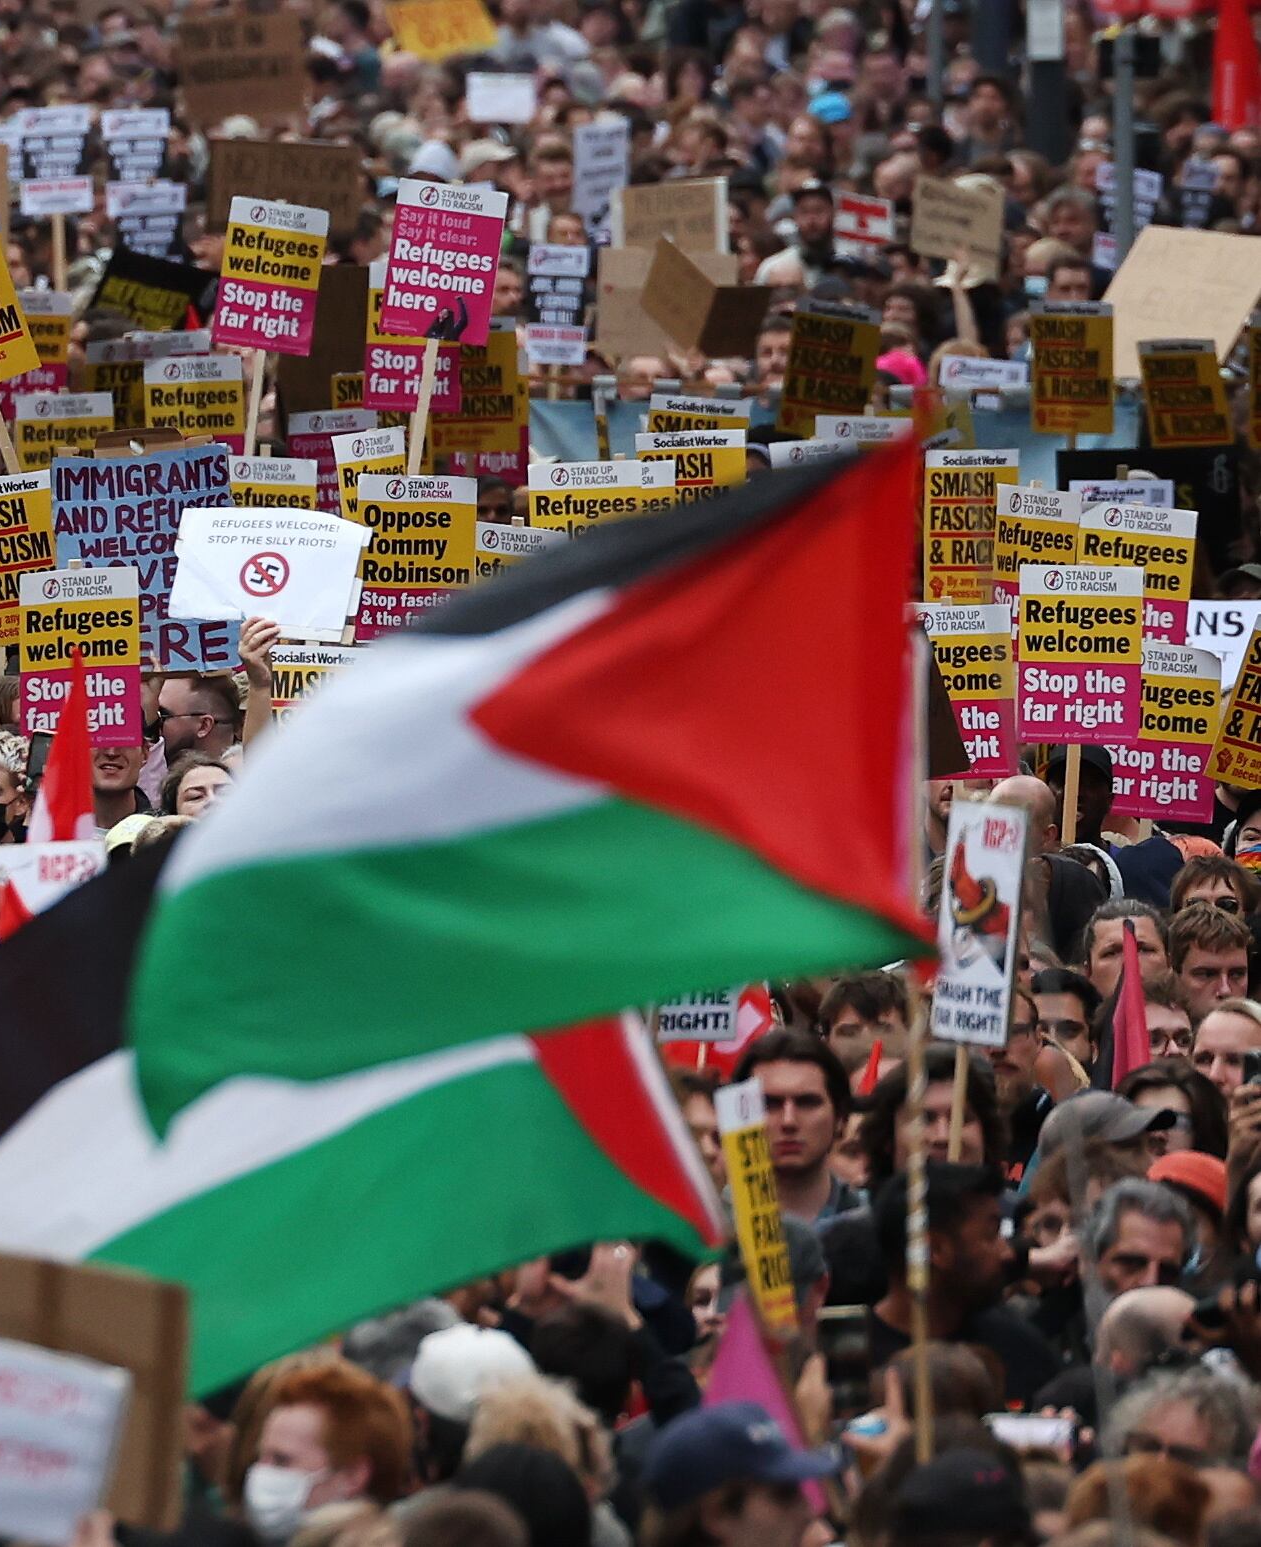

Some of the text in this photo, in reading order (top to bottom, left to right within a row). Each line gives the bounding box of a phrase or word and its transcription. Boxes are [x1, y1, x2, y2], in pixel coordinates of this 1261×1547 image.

[442, 190, 480, 202] STAND UP
[232, 228, 319, 259] Refugees
[398, 224, 478, 246] Say it clear:
[394, 239, 493, 273] Refugees
[229, 254, 311, 282] welcome
[391, 265, 485, 295] welcome
[223, 283, 303, 313] Stop the
[387, 285, 438, 312] here
[220, 307, 299, 338] far right
[150, 389, 238, 409] Refugees
[654, 436, 728, 448] Socialist Worker
[3, 479, 39, 493] Worker
[56, 454, 229, 500] IMMIGRANTS
[408, 481, 448, 490] STAND UP
[930, 472, 994, 498] SMASH
[409, 490, 452, 499] TO RACISM
[535, 495, 637, 519] Refugees
[1124, 509, 1168, 521] STAND UP
[212, 519, 340, 533] REFUGEES WELCOME!
[364, 504, 451, 535] Oppose
[208, 535, 337, 549] STOP THE SILLY RIOTS!
[369, 533, 447, 560] Tommy
[998, 520, 1073, 552] Refugees
[1084, 533, 1188, 567] Refugees
[62, 576, 108, 587] STAND UP
[363, 560, 469, 585] Robinson
[1066, 571, 1113, 581] STAND UP
[63, 586, 113, 596] TO RACISM
[1066, 581, 1117, 592] TO RACISM
[26, 608, 133, 634] Refugees
[361, 611, 401, 626] & the
[936, 610, 980, 621] STAND UP
[1025, 599, 1136, 628] Refugees
[937, 620, 985, 631] TO RACISM
[27, 638, 128, 662] welcome
[1025, 629, 1131, 654] welcome
[270, 652, 315, 664] Socialist
[1147, 651, 1193, 663] STAND UP
[1023, 668, 1126, 698] Stop the
[961, 706, 1000, 729] the
[1023, 698, 1124, 729] far right
[659, 1012, 729, 1031] RIGHT!
